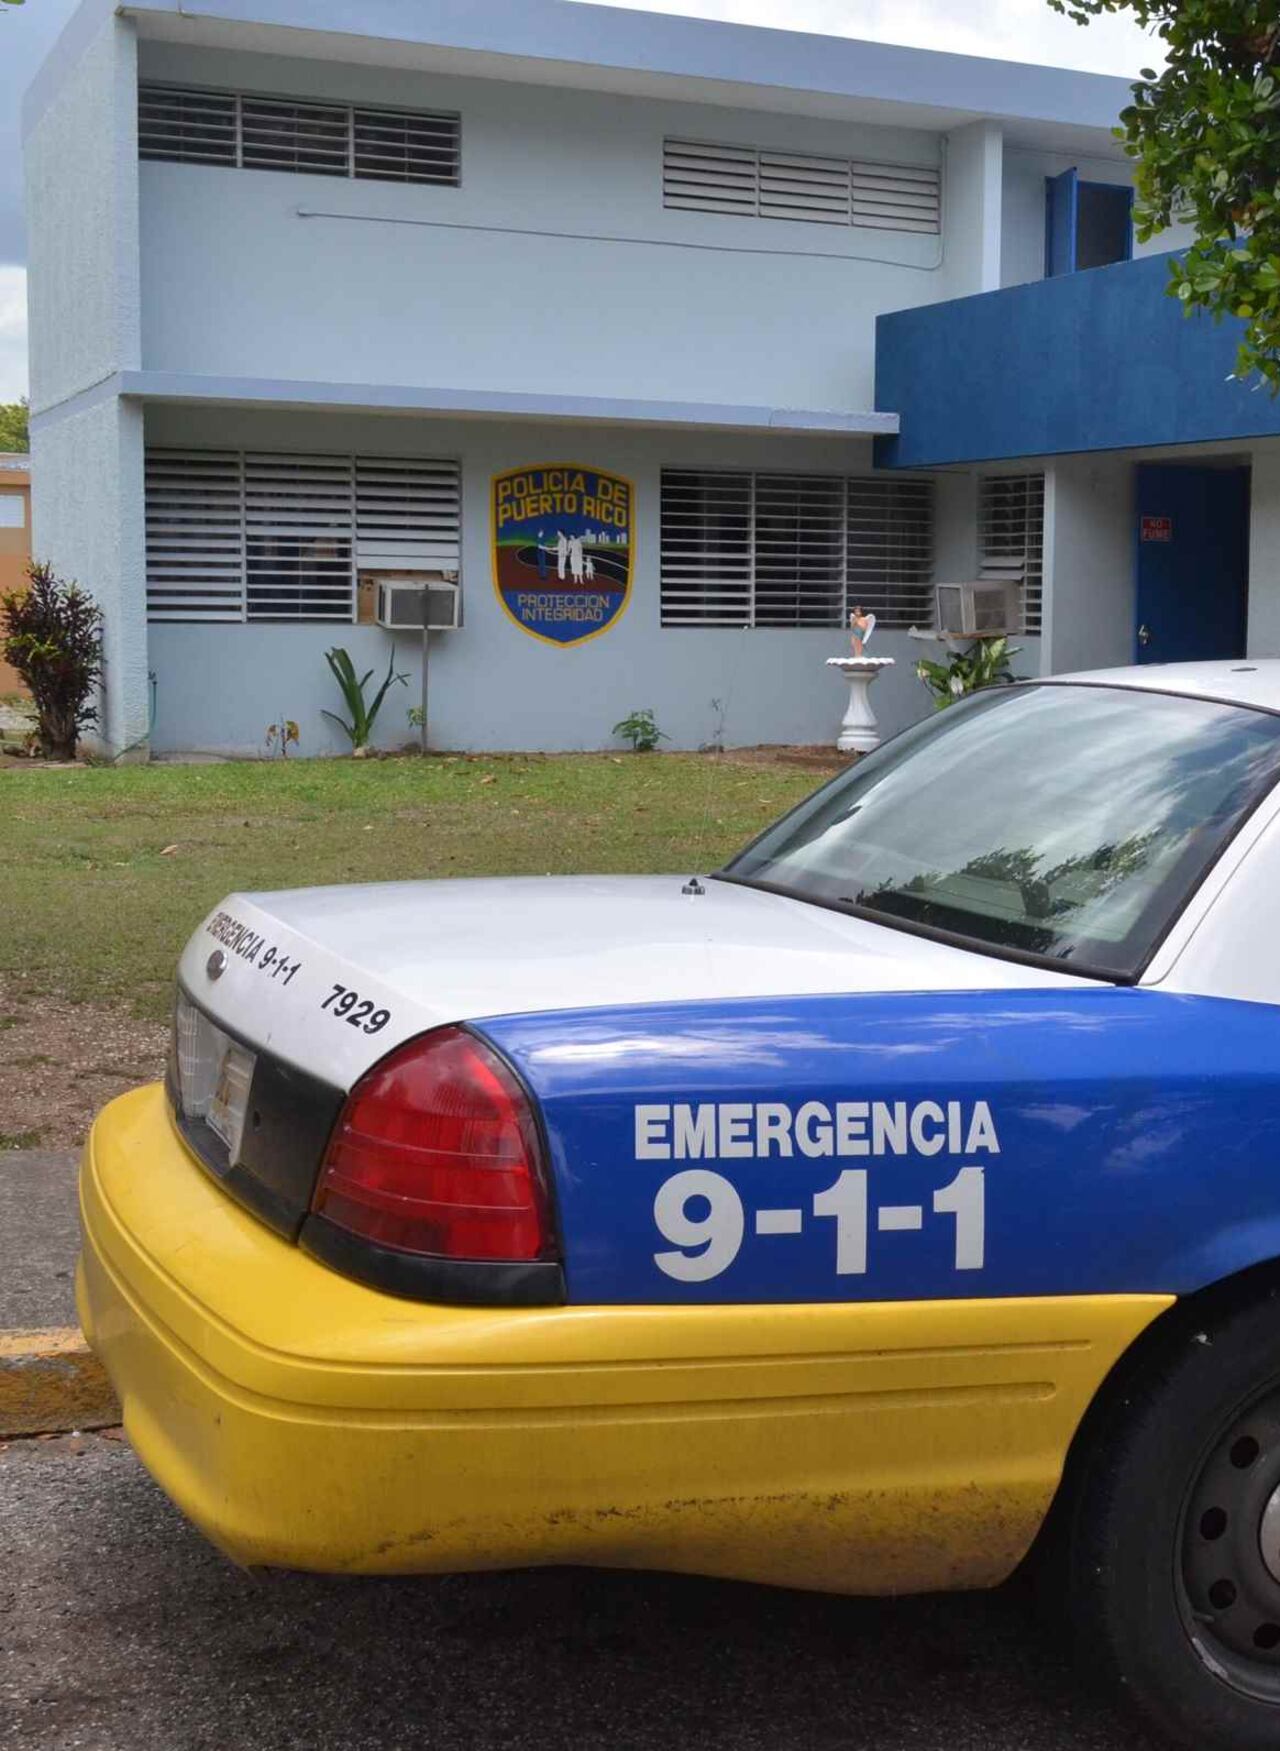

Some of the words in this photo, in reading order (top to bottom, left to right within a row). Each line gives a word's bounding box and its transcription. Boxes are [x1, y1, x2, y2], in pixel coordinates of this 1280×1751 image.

[498, 471, 585, 504] POLICIA
[597, 478, 628, 507] DE
[498, 493, 577, 528] PUERTO
[583, 496, 627, 528] RICO
[518, 594, 610, 609] PROTECCION
[521, 607, 604, 622] INTEGRIDAD
[205, 911, 266, 964] EMERGENCIA
[321, 983, 391, 1035] 7929
[634, 1100, 1001, 1160] EMERGENCIA
[653, 1166, 986, 1283] 9-1-1
